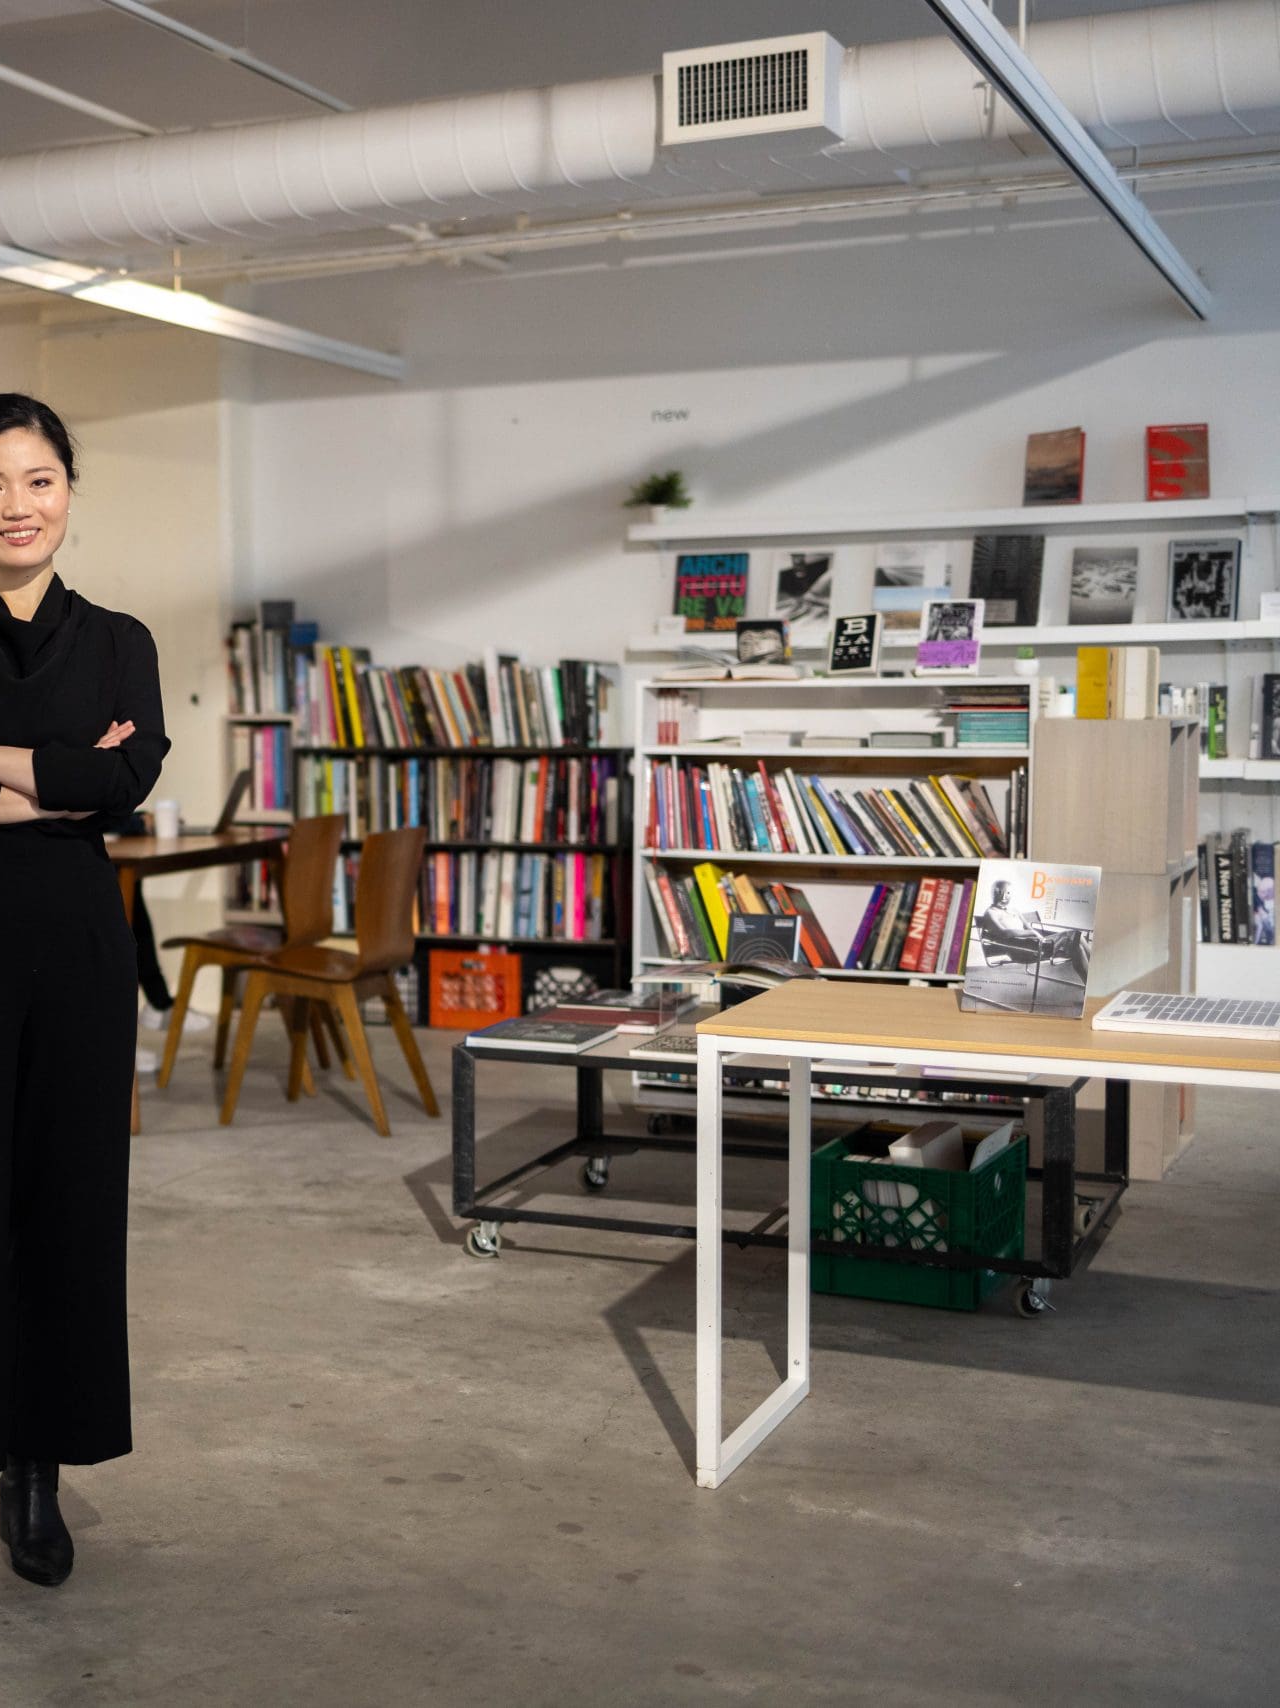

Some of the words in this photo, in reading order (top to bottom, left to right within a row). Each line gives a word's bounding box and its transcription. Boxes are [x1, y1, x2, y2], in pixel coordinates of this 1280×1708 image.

[651, 408, 691, 423] new
[678, 574, 747, 597] TECTU
[1219, 869, 1231, 896] New
[908, 879, 937, 940] LENIN
[1220, 898, 1232, 940] Nature
[926, 912, 944, 950] DAVID
